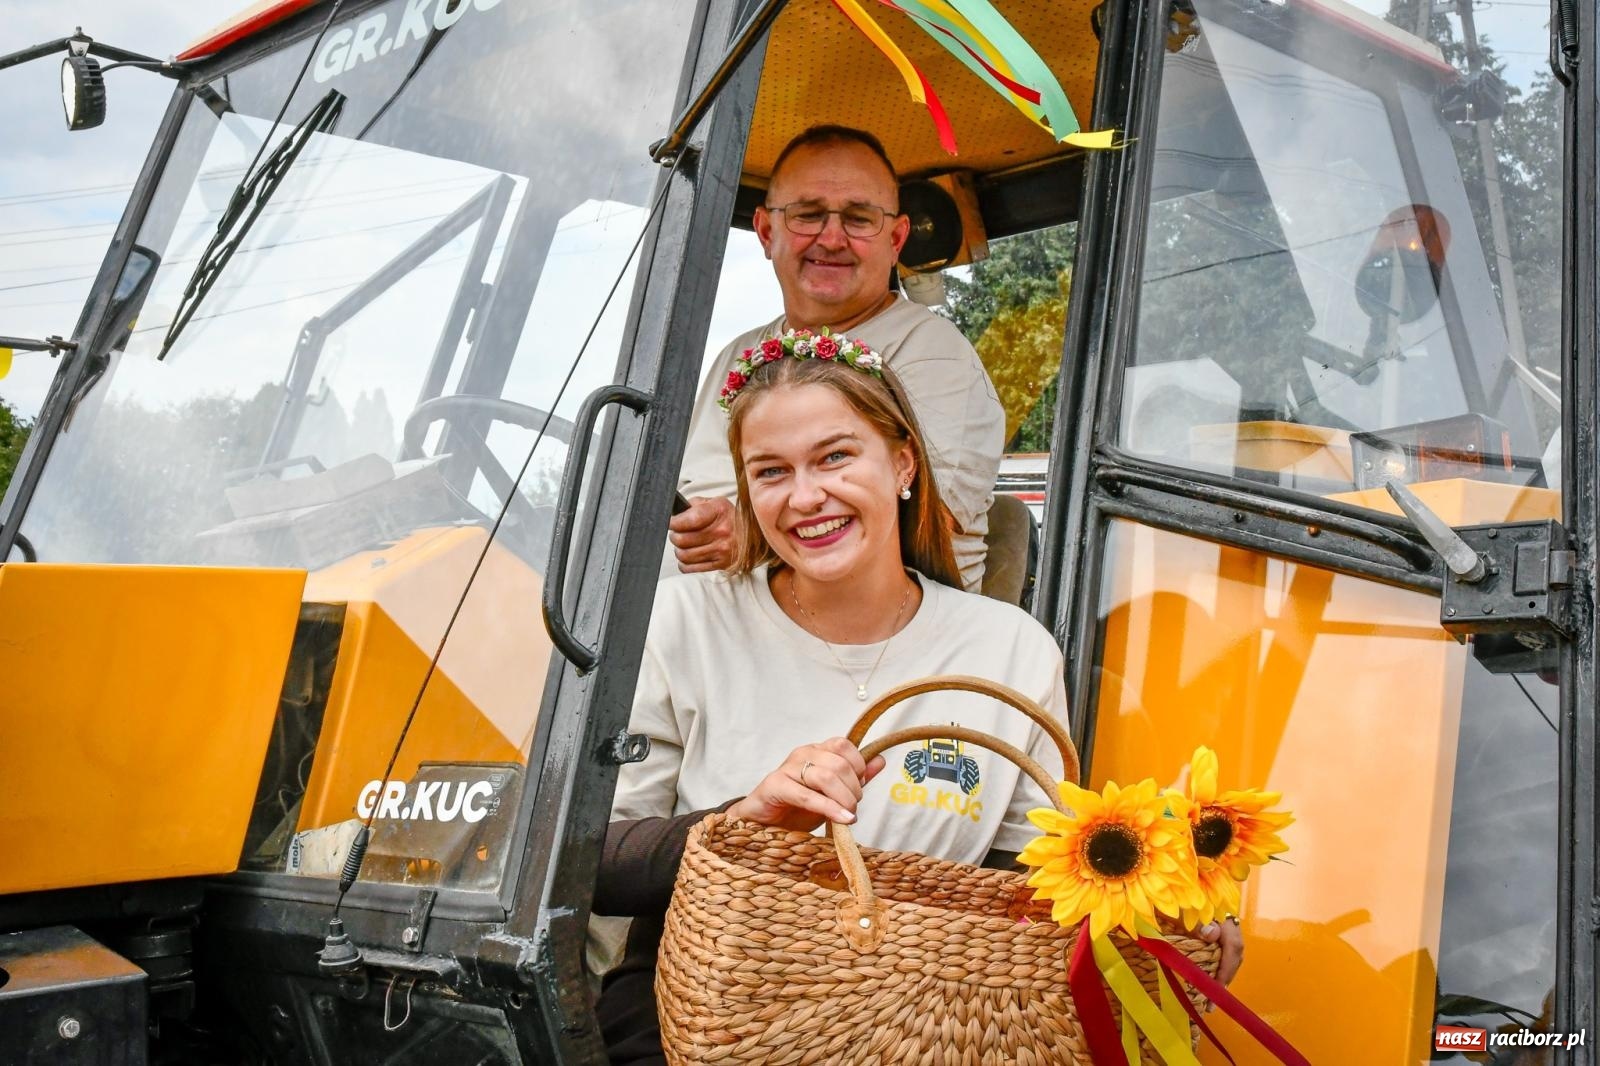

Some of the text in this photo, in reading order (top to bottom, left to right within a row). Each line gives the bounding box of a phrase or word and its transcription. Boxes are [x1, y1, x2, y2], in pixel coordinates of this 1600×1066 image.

[313, 0, 501, 84] GR.KU
[357, 780, 493, 823] GR.KUC
[890, 783, 983, 823] GR.KUC
